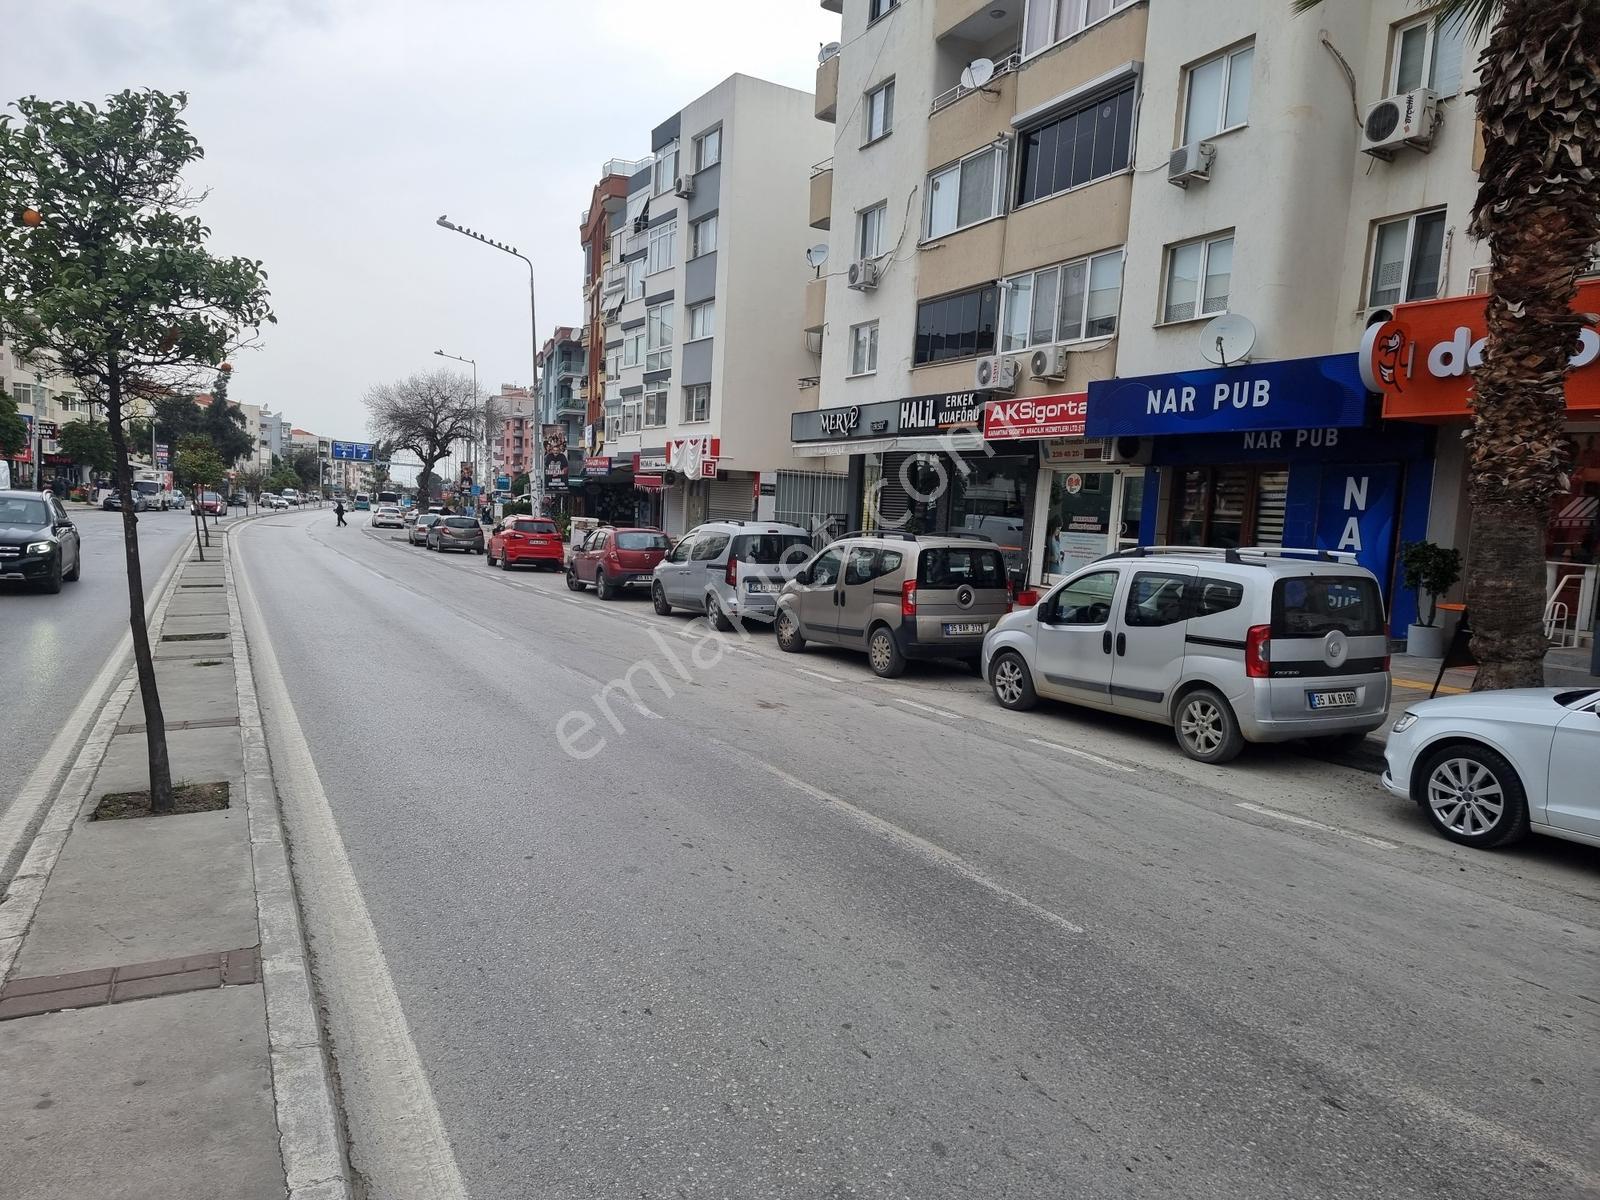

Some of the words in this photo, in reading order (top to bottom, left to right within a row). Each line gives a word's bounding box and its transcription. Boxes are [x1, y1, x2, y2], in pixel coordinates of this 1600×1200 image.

[945, 393, 974, 407] ERKEK
[1147, 387, 1196, 414] NAR
[1213, 379, 1271, 410] PUB
[820, 406, 858, 435] MERVE
[938, 405, 980, 424] KUAFÖRÜ
[1243, 430, 1282, 449] NAR
[1296, 427, 1338, 447] PUB
[1315, 695, 1325, 705] 35
